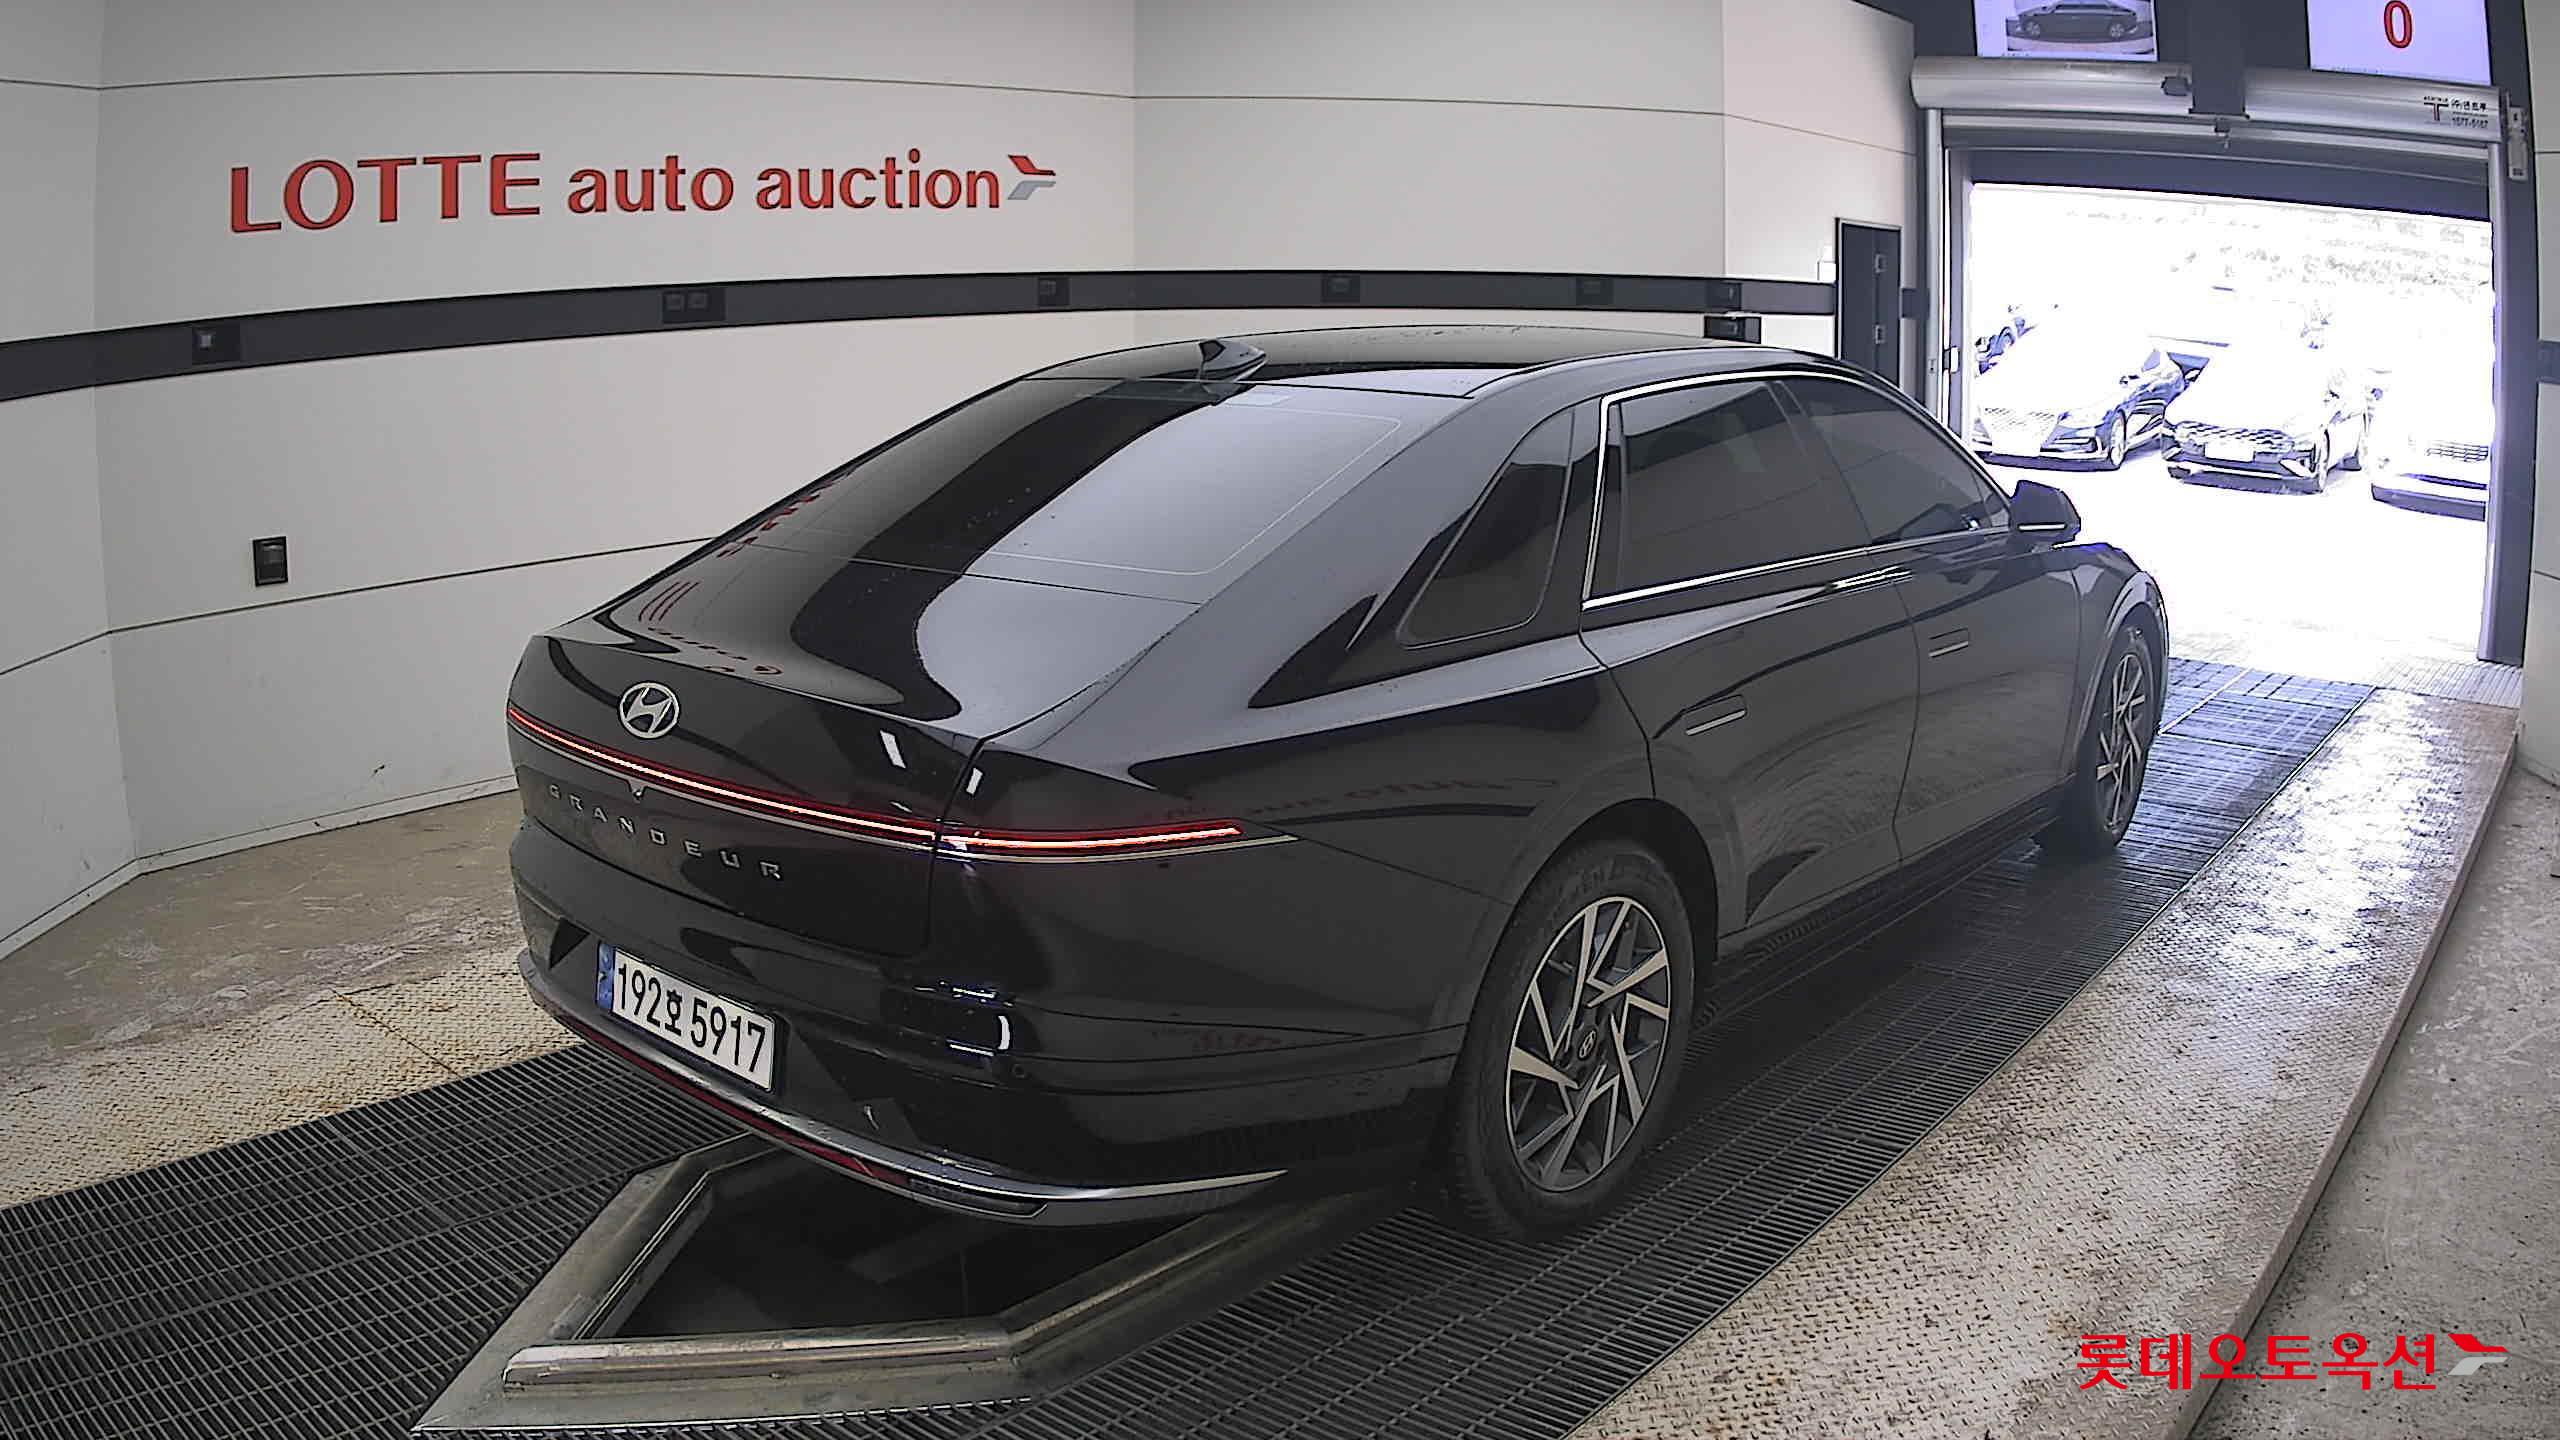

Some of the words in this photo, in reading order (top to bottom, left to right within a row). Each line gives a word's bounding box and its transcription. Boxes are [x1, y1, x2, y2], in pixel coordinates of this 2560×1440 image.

[2384, 0, 2413, 48] 0
[231, 152, 541, 233] LOTTE
[568, 154, 734, 214] auto
[756, 147, 1000, 210] auction
[548, 783, 782, 880] GRANDEUR
[618, 963, 684, 1037] 192호
[690, 996, 766, 1073] 5917
